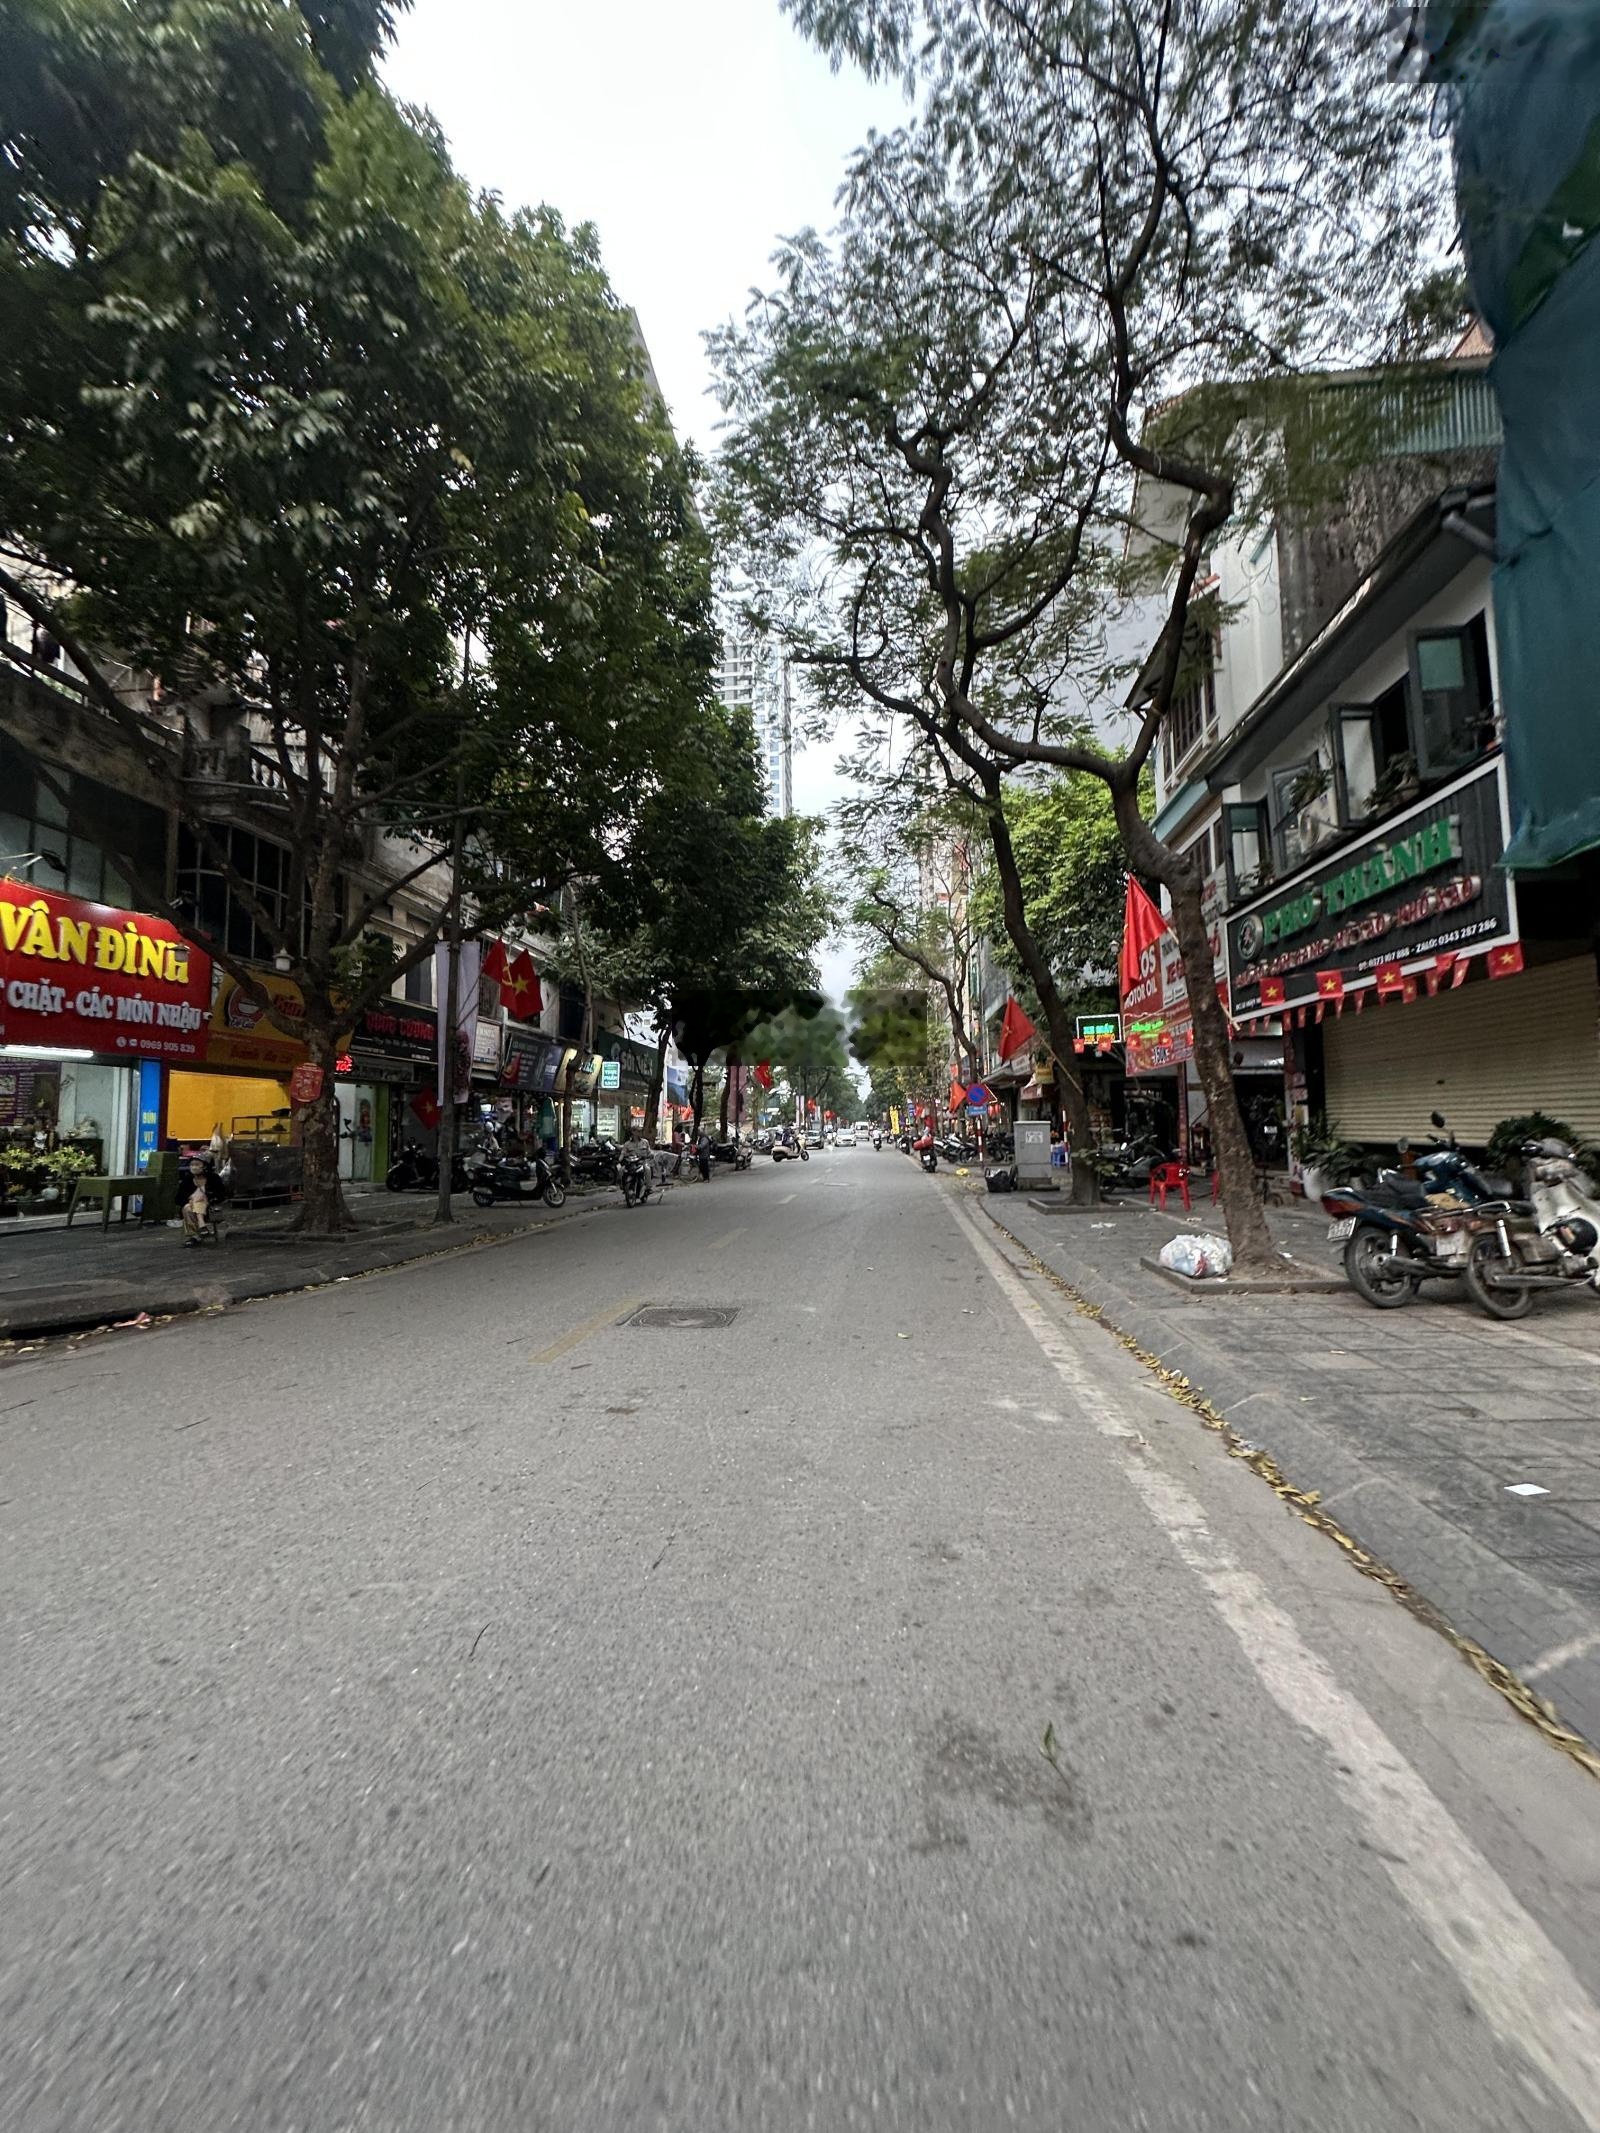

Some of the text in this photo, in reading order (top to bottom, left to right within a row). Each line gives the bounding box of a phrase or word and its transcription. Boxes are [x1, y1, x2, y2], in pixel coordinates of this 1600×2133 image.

[0, 899, 190, 985] VÂN ĐÌNH
[1437, 930, 1460, 947] 0343
[1460, 924, 1477, 939] 287
[1478, 917, 1497, 933] 286
[7, 977, 66, 1017] CHẶT
[76, 986, 114, 1019] CÁC
[116, 992, 154, 1024] MÓN
[156, 1001, 201, 1034] NHẬU
[1146, 976, 1158, 997] OIL
